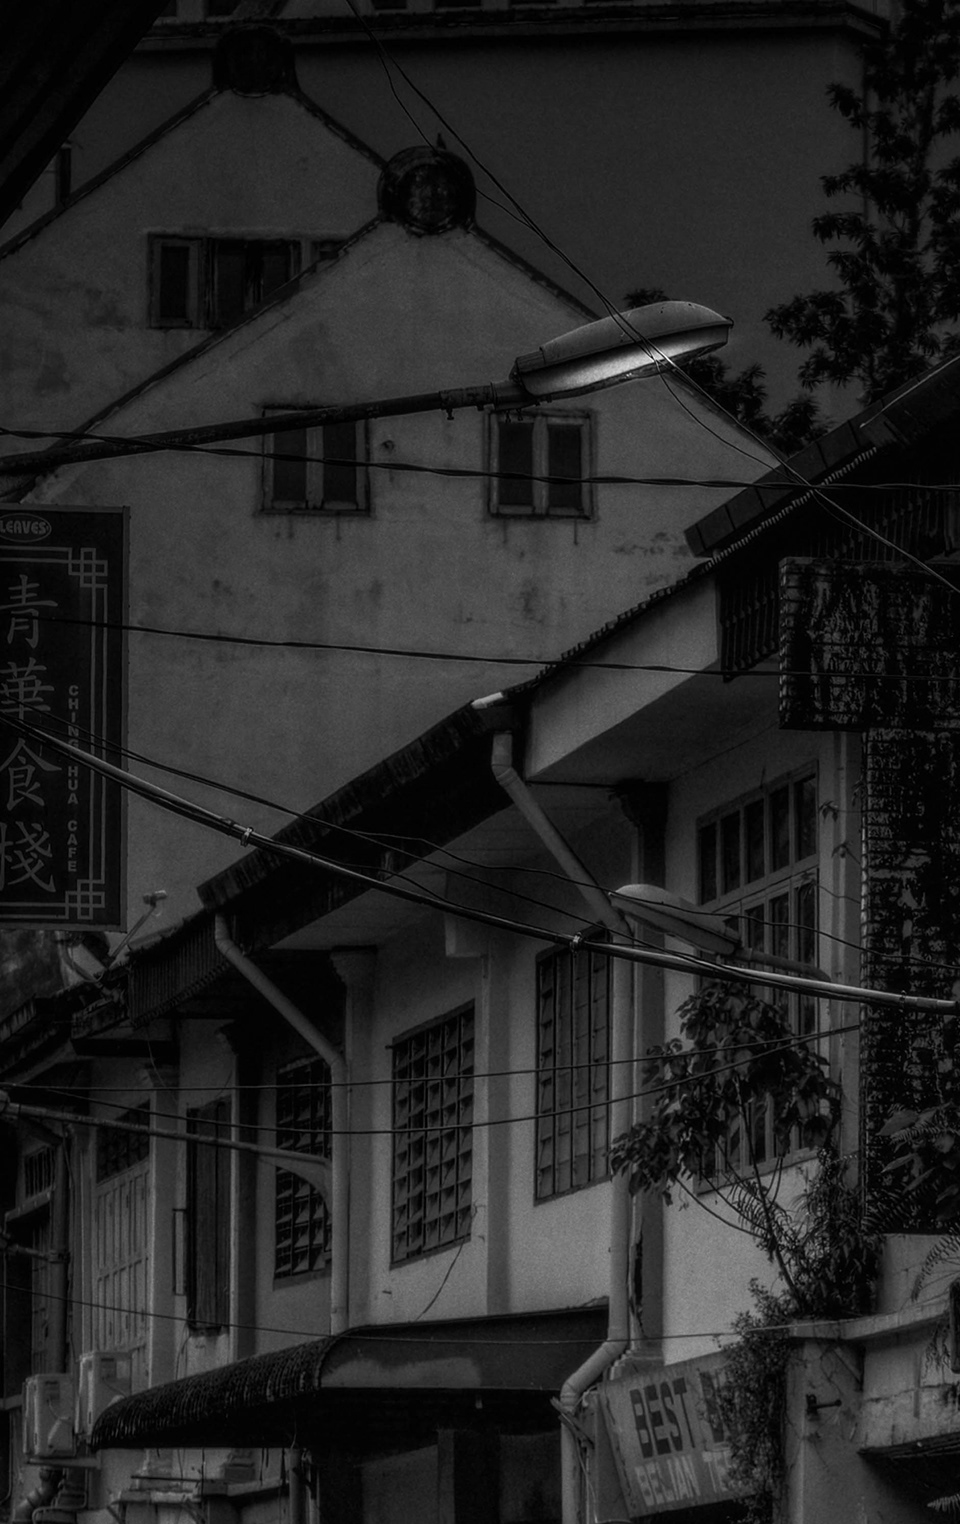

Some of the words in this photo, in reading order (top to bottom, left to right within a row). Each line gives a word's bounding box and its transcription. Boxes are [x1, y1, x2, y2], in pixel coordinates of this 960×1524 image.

[67, 765, 80, 806] HUA
[67, 819, 80, 873] CAFE
[629, 1376, 696, 1460] BEST
